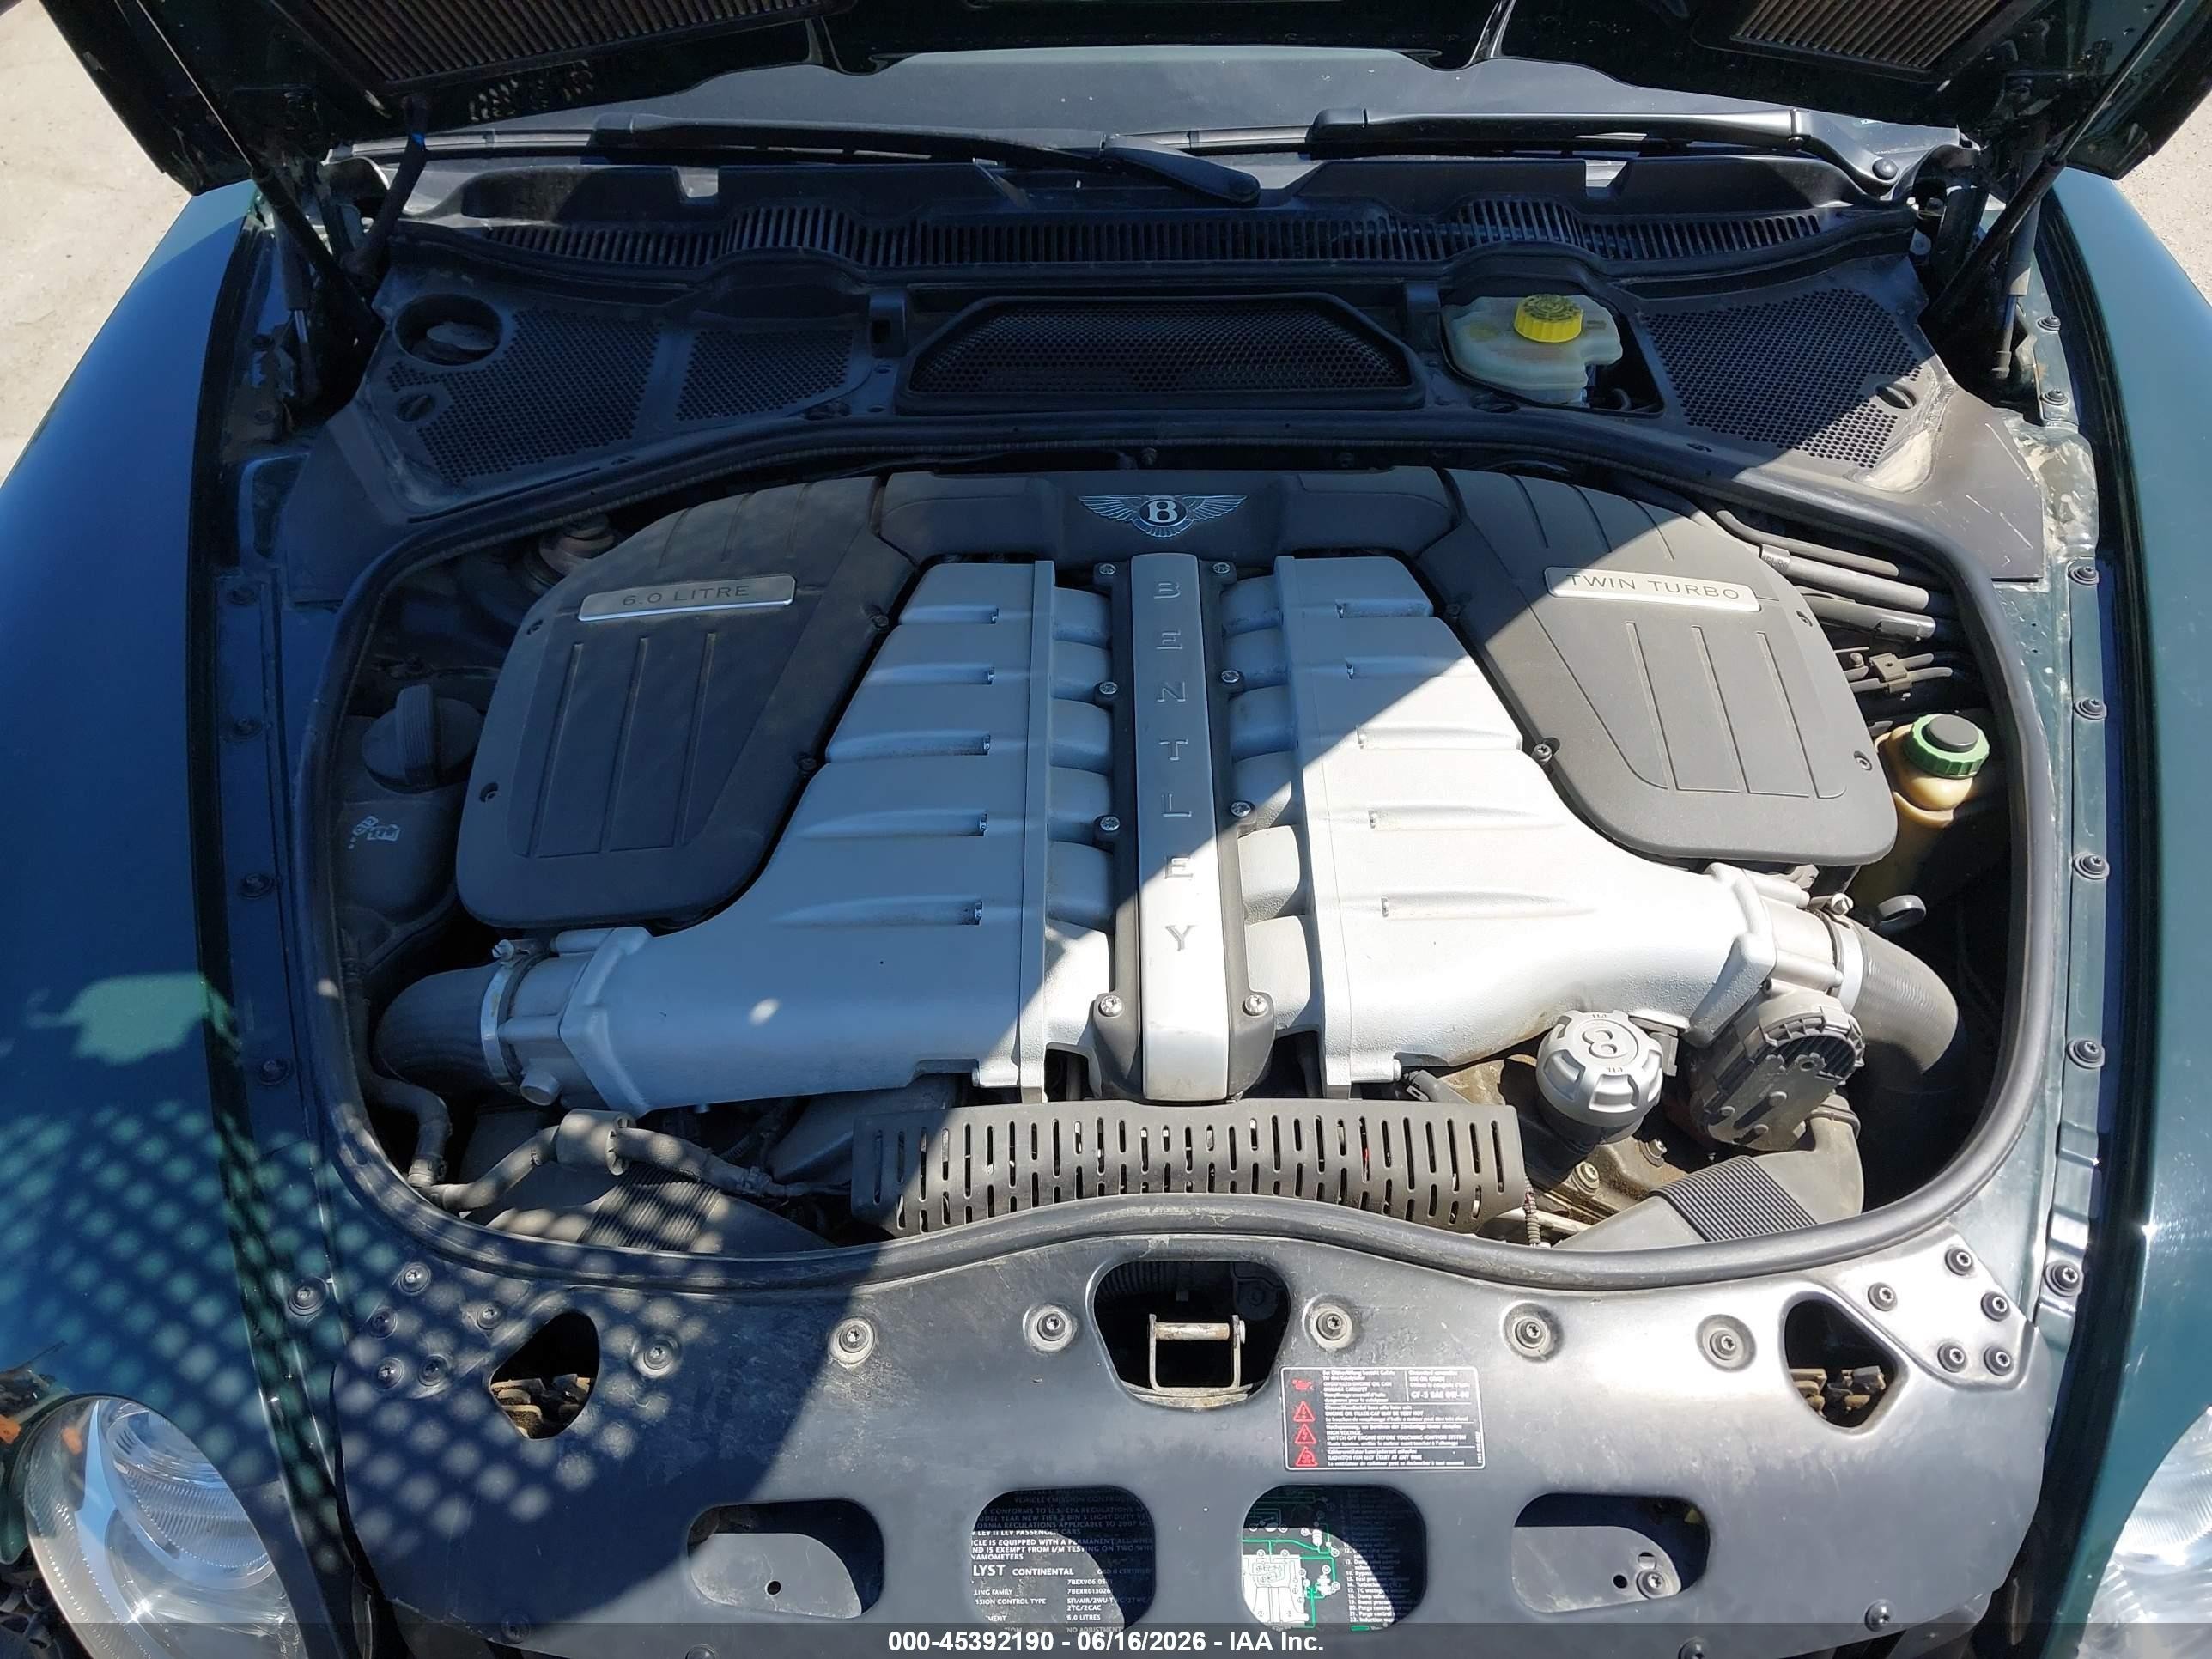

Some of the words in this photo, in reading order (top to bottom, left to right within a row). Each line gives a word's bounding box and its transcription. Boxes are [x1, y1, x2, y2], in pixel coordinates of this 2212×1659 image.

[623, 592, 662, 606] 6.0
[673, 585, 750, 602] LITRE
[1566, 574, 1636, 590] TWIN
[1648, 580, 1740, 599] TURBO
